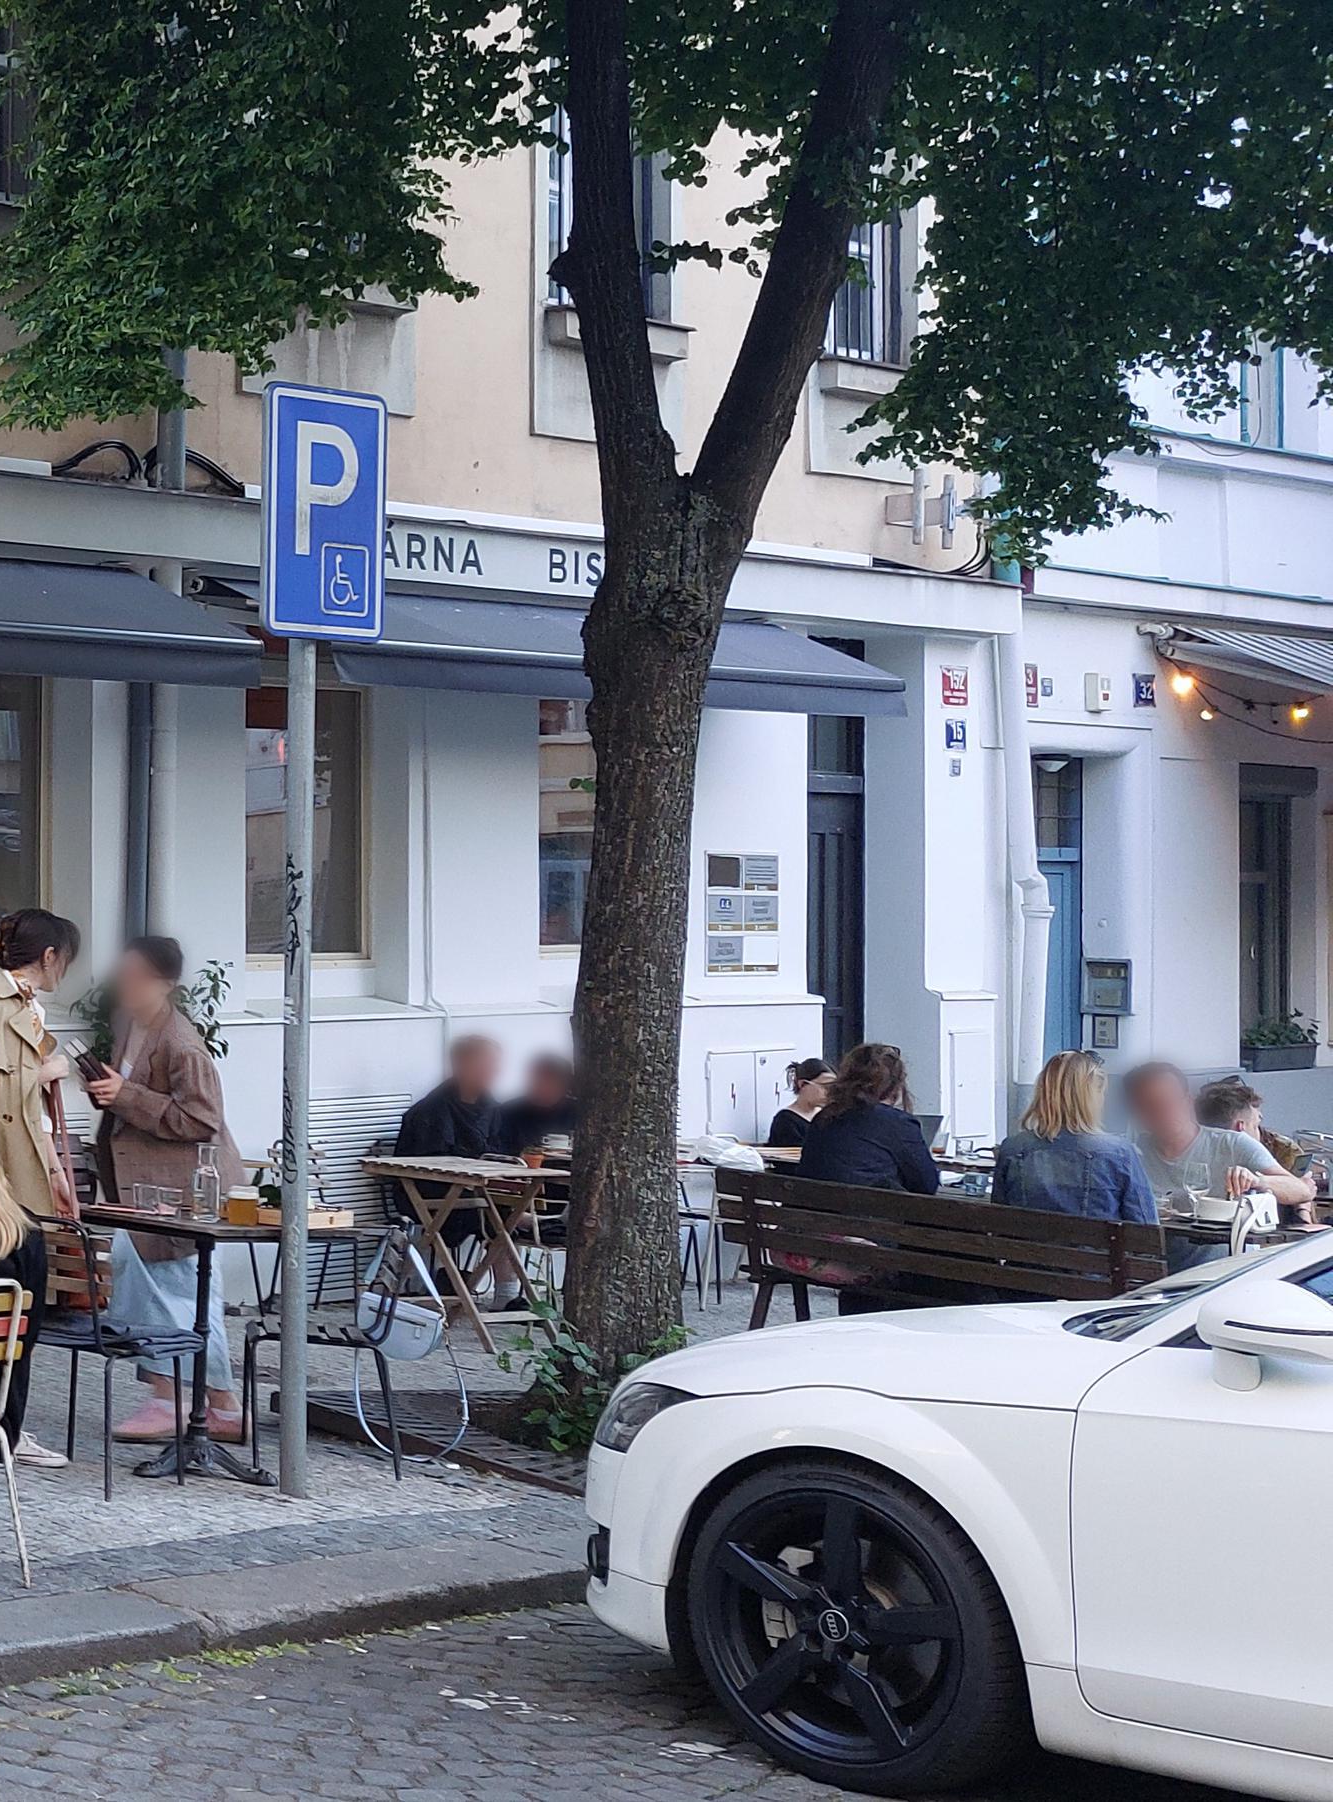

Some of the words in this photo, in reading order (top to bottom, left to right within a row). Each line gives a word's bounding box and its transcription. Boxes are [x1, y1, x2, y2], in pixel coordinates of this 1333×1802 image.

[295, 420, 360, 556] P
[385, 519, 484, 576] ÁRNA
[549, 548, 606, 587] BIS
[1140, 682, 1153, 699] 32
